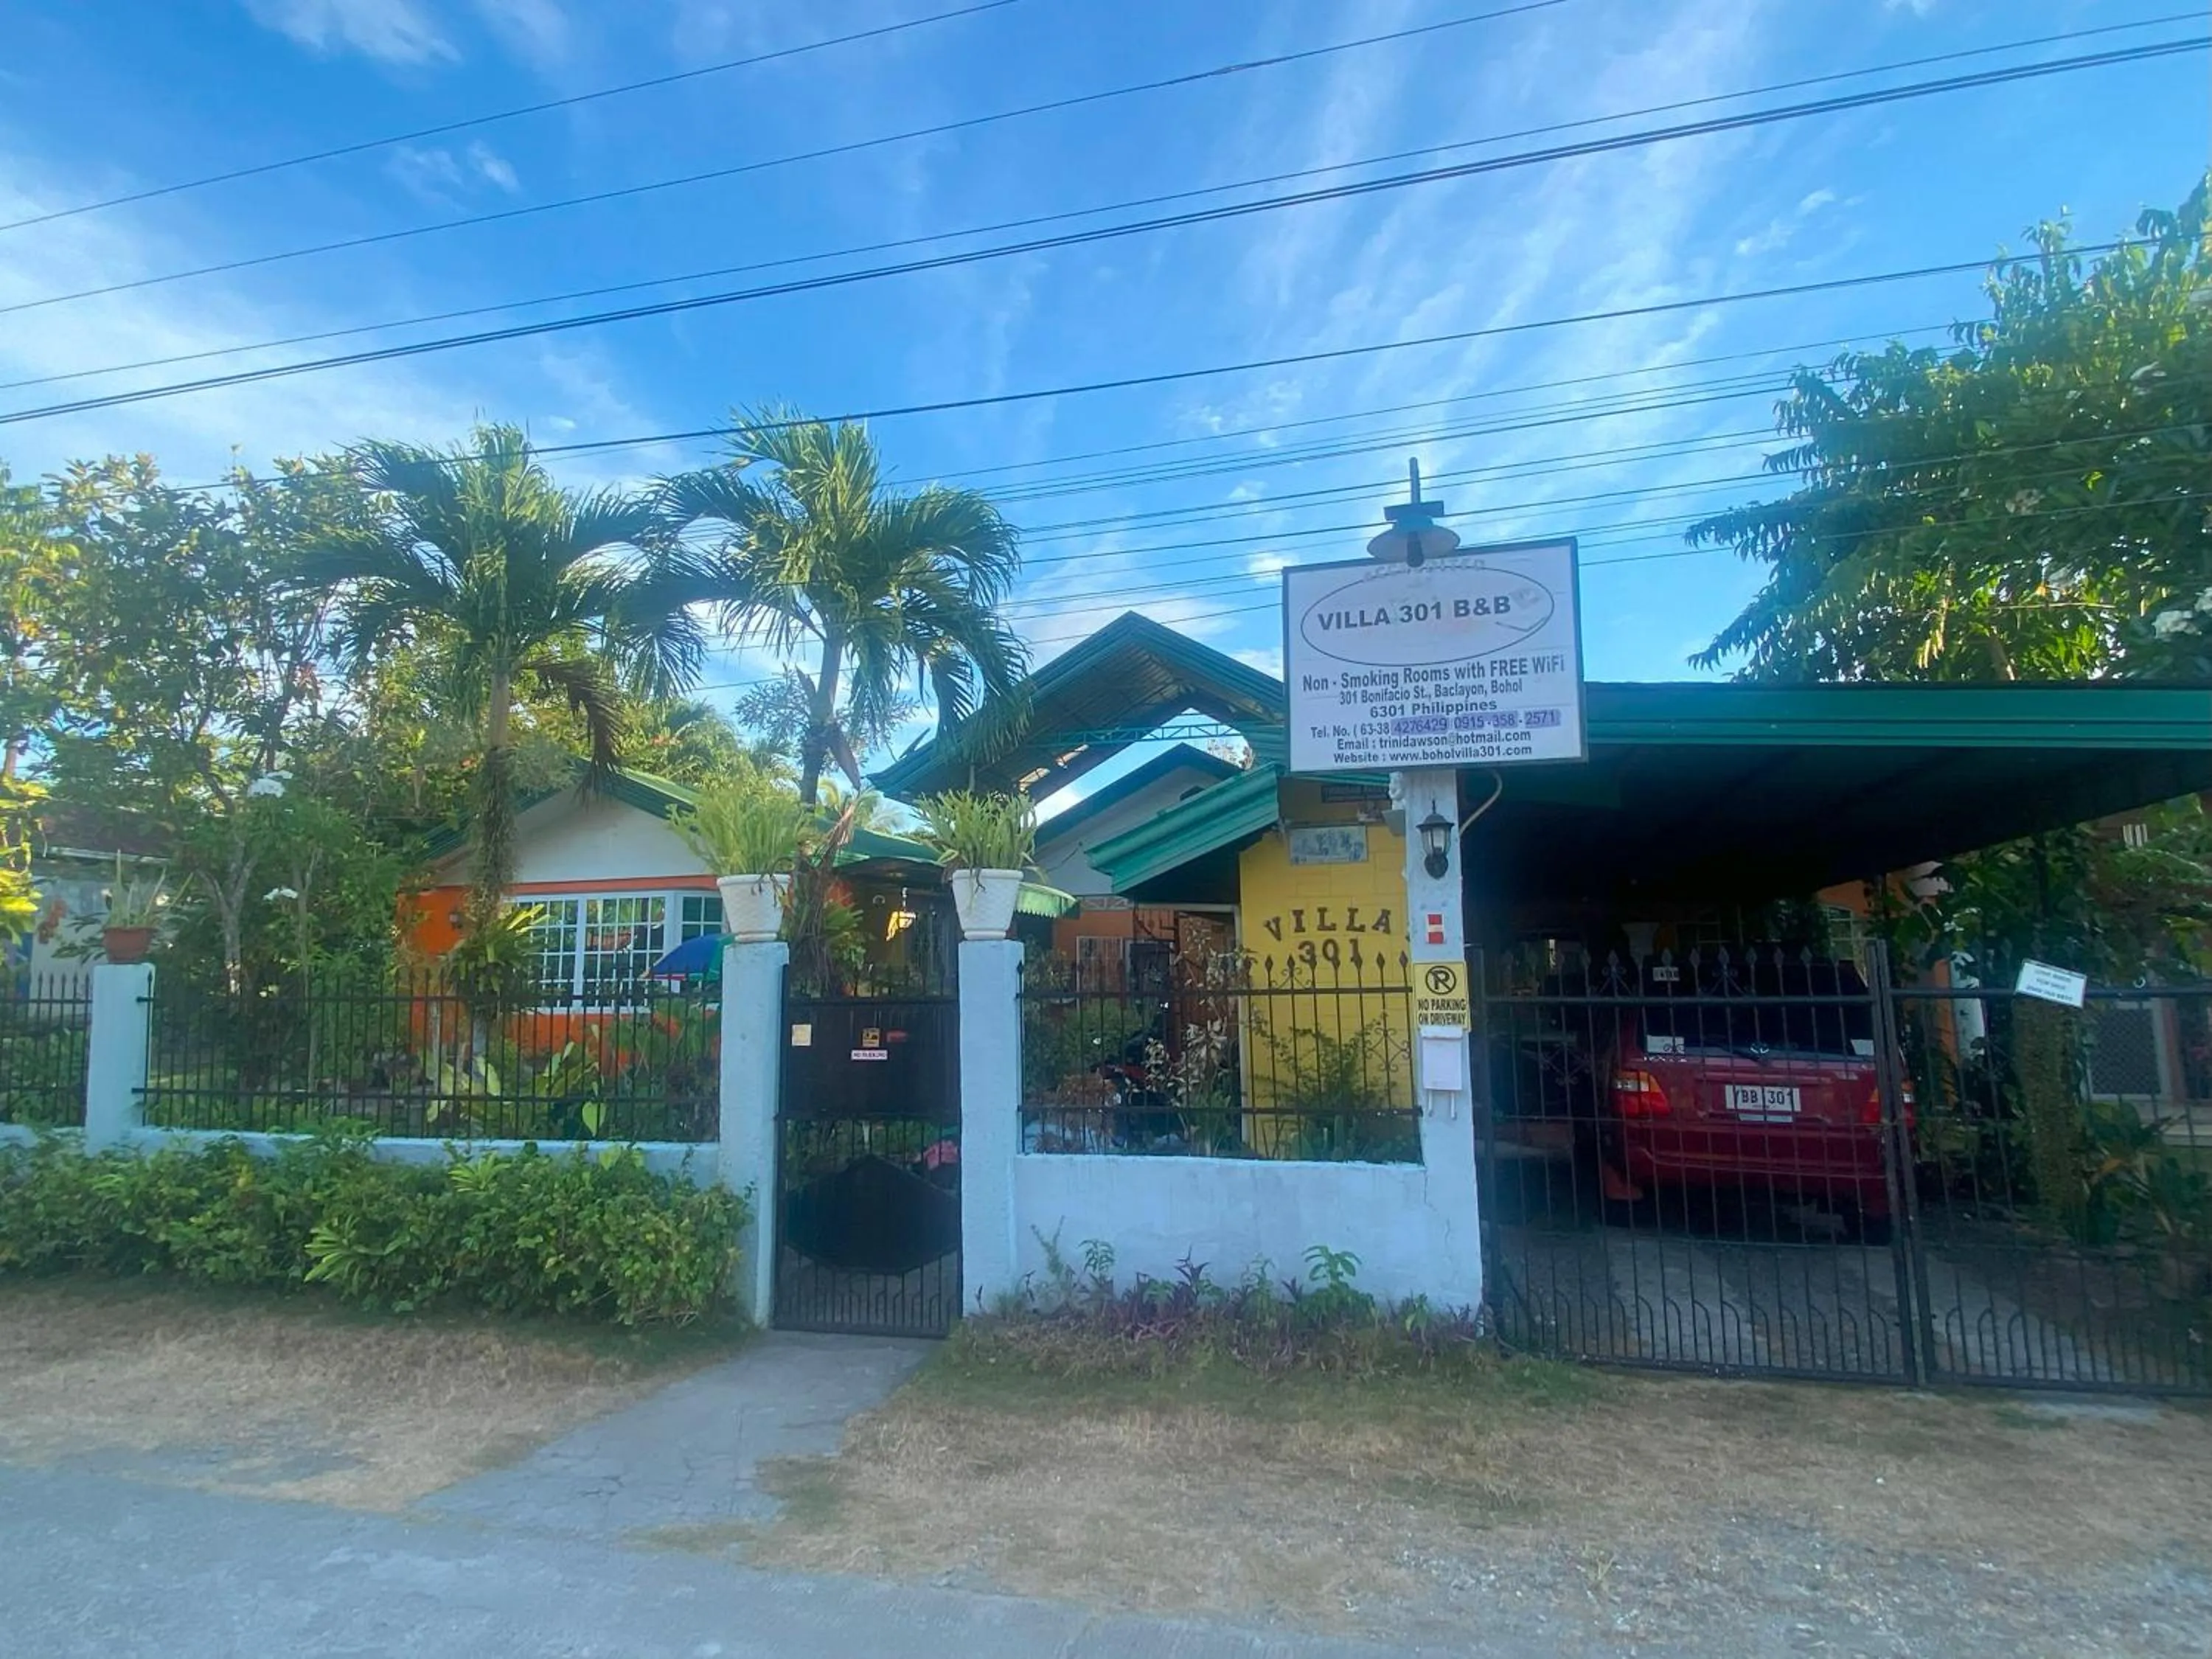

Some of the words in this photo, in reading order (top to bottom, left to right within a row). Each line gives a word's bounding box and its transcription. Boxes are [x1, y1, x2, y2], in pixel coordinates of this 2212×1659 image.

[1317, 608, 1391, 630] VILLA
[1399, 602, 1441, 623] 301
[1453, 596, 1511, 618] B&B
[1303, 675, 1329, 692] Non
[1340, 669, 1399, 689] Smoking
[1403, 667, 1450, 684] Rooms
[1454, 662, 1486, 680] with
[1490, 658, 1528, 677] FREE
[1532, 654, 1565, 674] WiFi
[1340, 691, 1357, 705] 301
[1361, 687, 1411, 703] Bonifacio
[1435, 682, 1488, 700] Baclayon,
[1491, 678, 1523, 694] Bohol
[1370, 704, 1405, 718] 6301
[1412, 700, 1498, 715] Philippines
[1310, 726, 1329, 738] Tel.
[1333, 725, 1351, 737] No.
[1390, 745, 1533, 762] www.boholvilla301.com
[1264, 907, 1391, 942] VILLA
[1298, 937, 1360, 964] 301
[1417, 998, 1430, 1011] NO
[1431, 998, 1466, 1011] PARKING
[1430, 1012, 1466, 1026] DRIVEWAY
